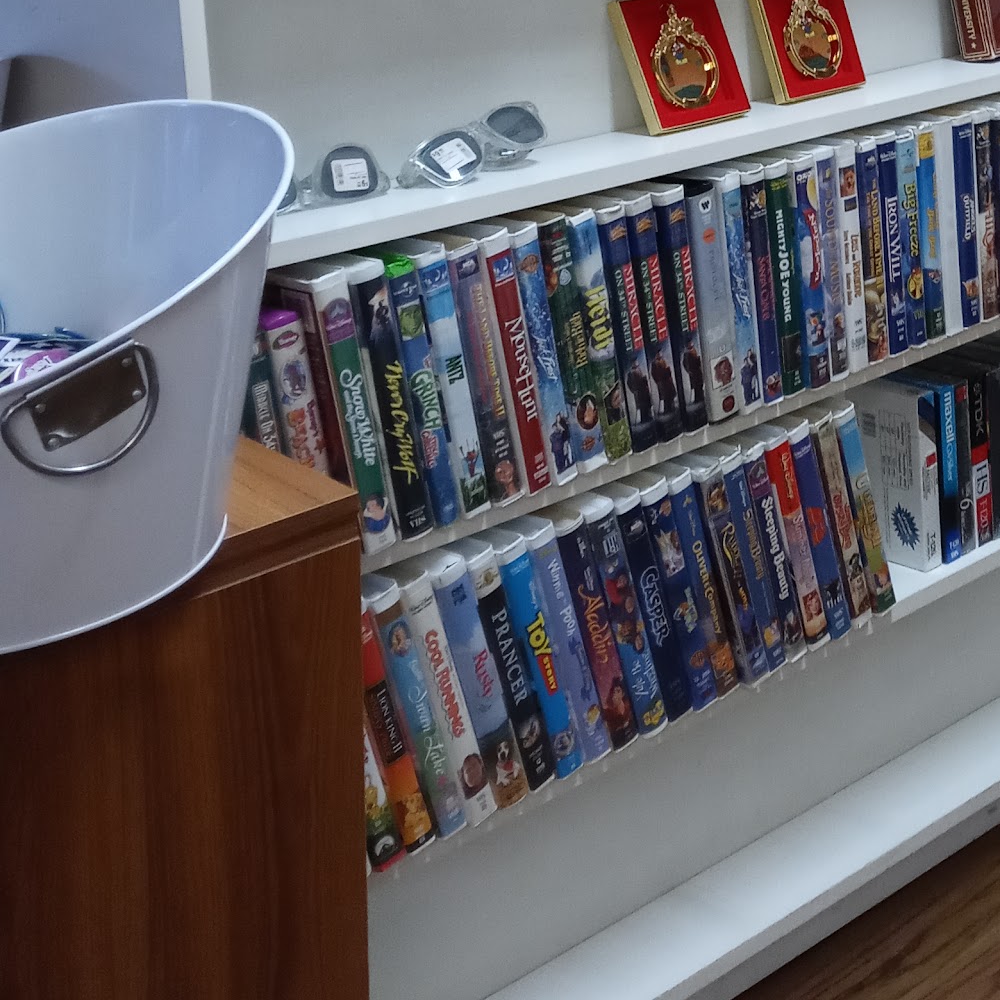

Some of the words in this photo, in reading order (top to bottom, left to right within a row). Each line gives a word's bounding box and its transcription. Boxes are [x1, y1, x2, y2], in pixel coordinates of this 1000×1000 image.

[774, 209, 788, 250] MIGHTY
[886, 196, 899, 239] IRON
[903, 183, 917, 210] Big
[905, 211, 919, 258] Freeze
[648, 254, 669, 341] MIRACLE
[673, 251, 683, 269] ON
[678, 290, 690, 333] STREET
[680, 245, 698, 332] MIRACLE
[778, 249, 791, 280] JOE
[888, 236, 902, 283] WILL
[584, 285, 614, 350] Heidi
[614, 270, 624, 287] ON
[620, 307, 633, 352] STREET
[622, 263, 644, 350] MIRACLE
[640, 261, 650, 278] ON
[645, 298, 658, 343] STREET
[782, 279, 793, 323] YOUNG
[411, 369, 442, 430] GRINCH
[445, 353, 465, 386] ANTZ
[504, 317, 538, 423] MouseHunt
[339, 368, 368, 424] Snow
[354, 418, 377, 467] White
[943, 391, 956, 443] maxell
[973, 395, 985, 437] TDK
[976, 464, 989, 499] HS
[692, 540, 711, 583] OLIVER
[703, 586, 722, 635] Company
[760, 494, 781, 553] Sleeping
[772, 548, 789, 601] Beauty
[547, 556, 565, 600] Winnie
[559, 607, 575, 638] Pooh
[578, 584, 609, 665] Aladdin
[640, 565, 670, 648] CASPER
[424, 629, 443, 671] COOL
[436, 667, 465, 738] RUNNINGS
[473, 649, 493, 699] Rusty
[491, 606, 528, 706] PRANCER
[526, 611, 552, 657] TOY
[541, 655, 558, 691] STORY
[377, 687, 390, 716] LION
[384, 715, 397, 745] KING
[408, 684, 430, 732] Swan
[424, 734, 444, 777] Lake
